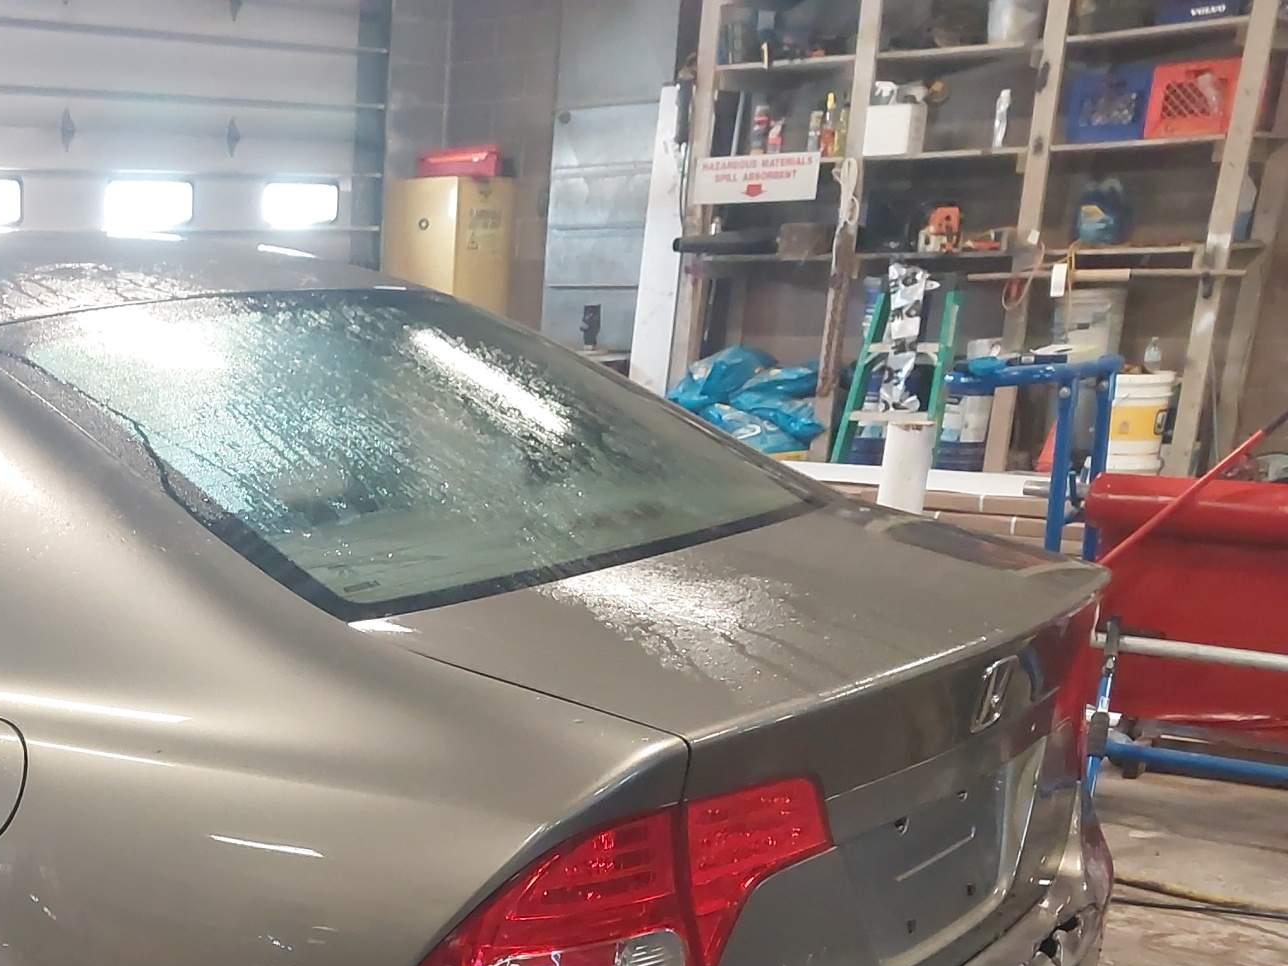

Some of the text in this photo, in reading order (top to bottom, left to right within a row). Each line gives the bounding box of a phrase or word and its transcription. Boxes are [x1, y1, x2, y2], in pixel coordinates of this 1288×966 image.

[702, 156, 814, 171] HAZARDOUS MATERIALS
[743, 169, 798, 181] ABSORBENT
